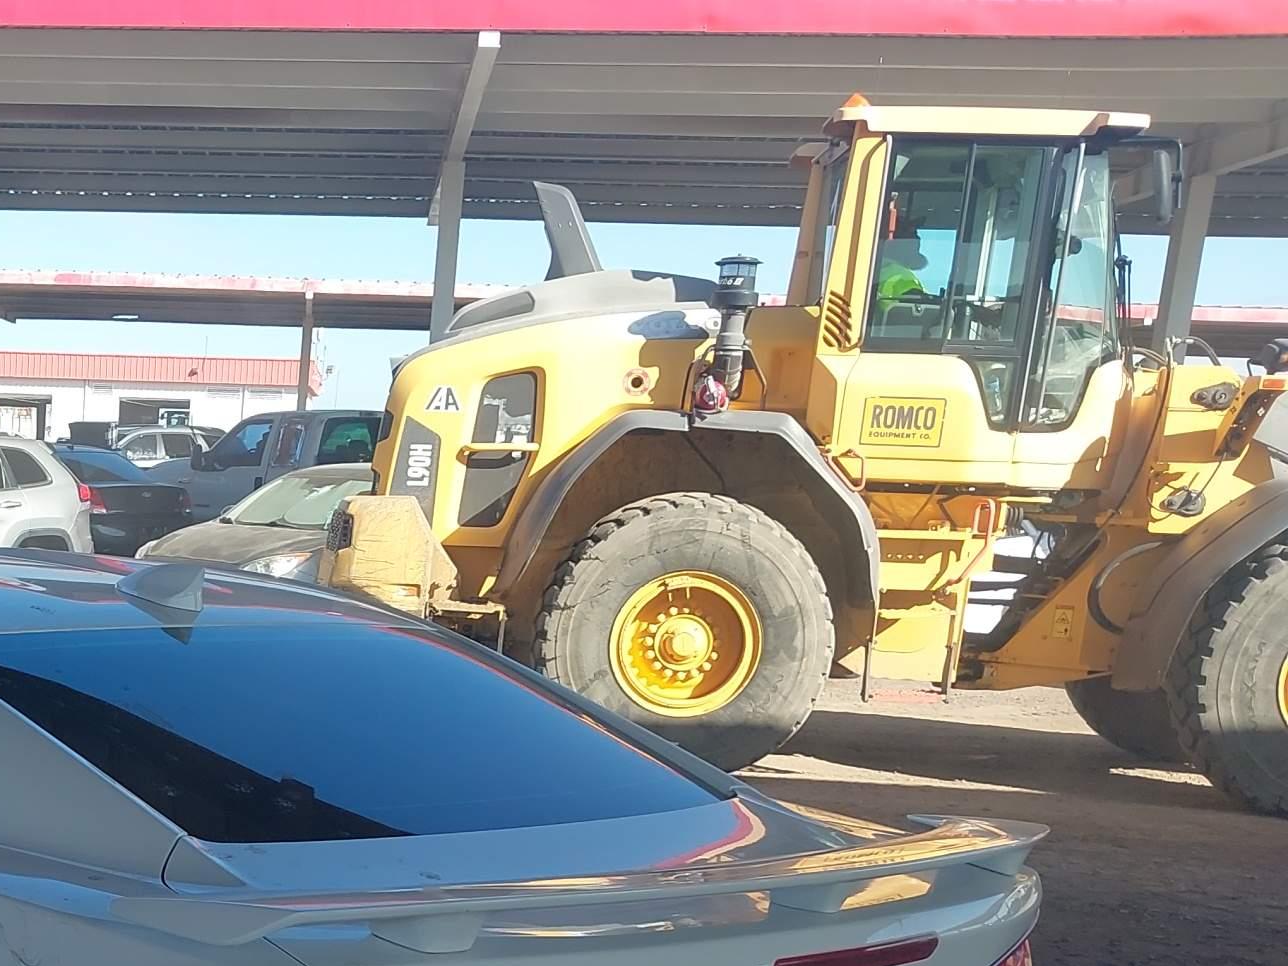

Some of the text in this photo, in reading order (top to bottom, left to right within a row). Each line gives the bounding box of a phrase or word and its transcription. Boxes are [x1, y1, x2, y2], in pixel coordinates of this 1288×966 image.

[870, 404, 937, 430] ROMCO
[868, 431, 916, 439] EQUIPMENT
[406, 444, 433, 487] L90H
